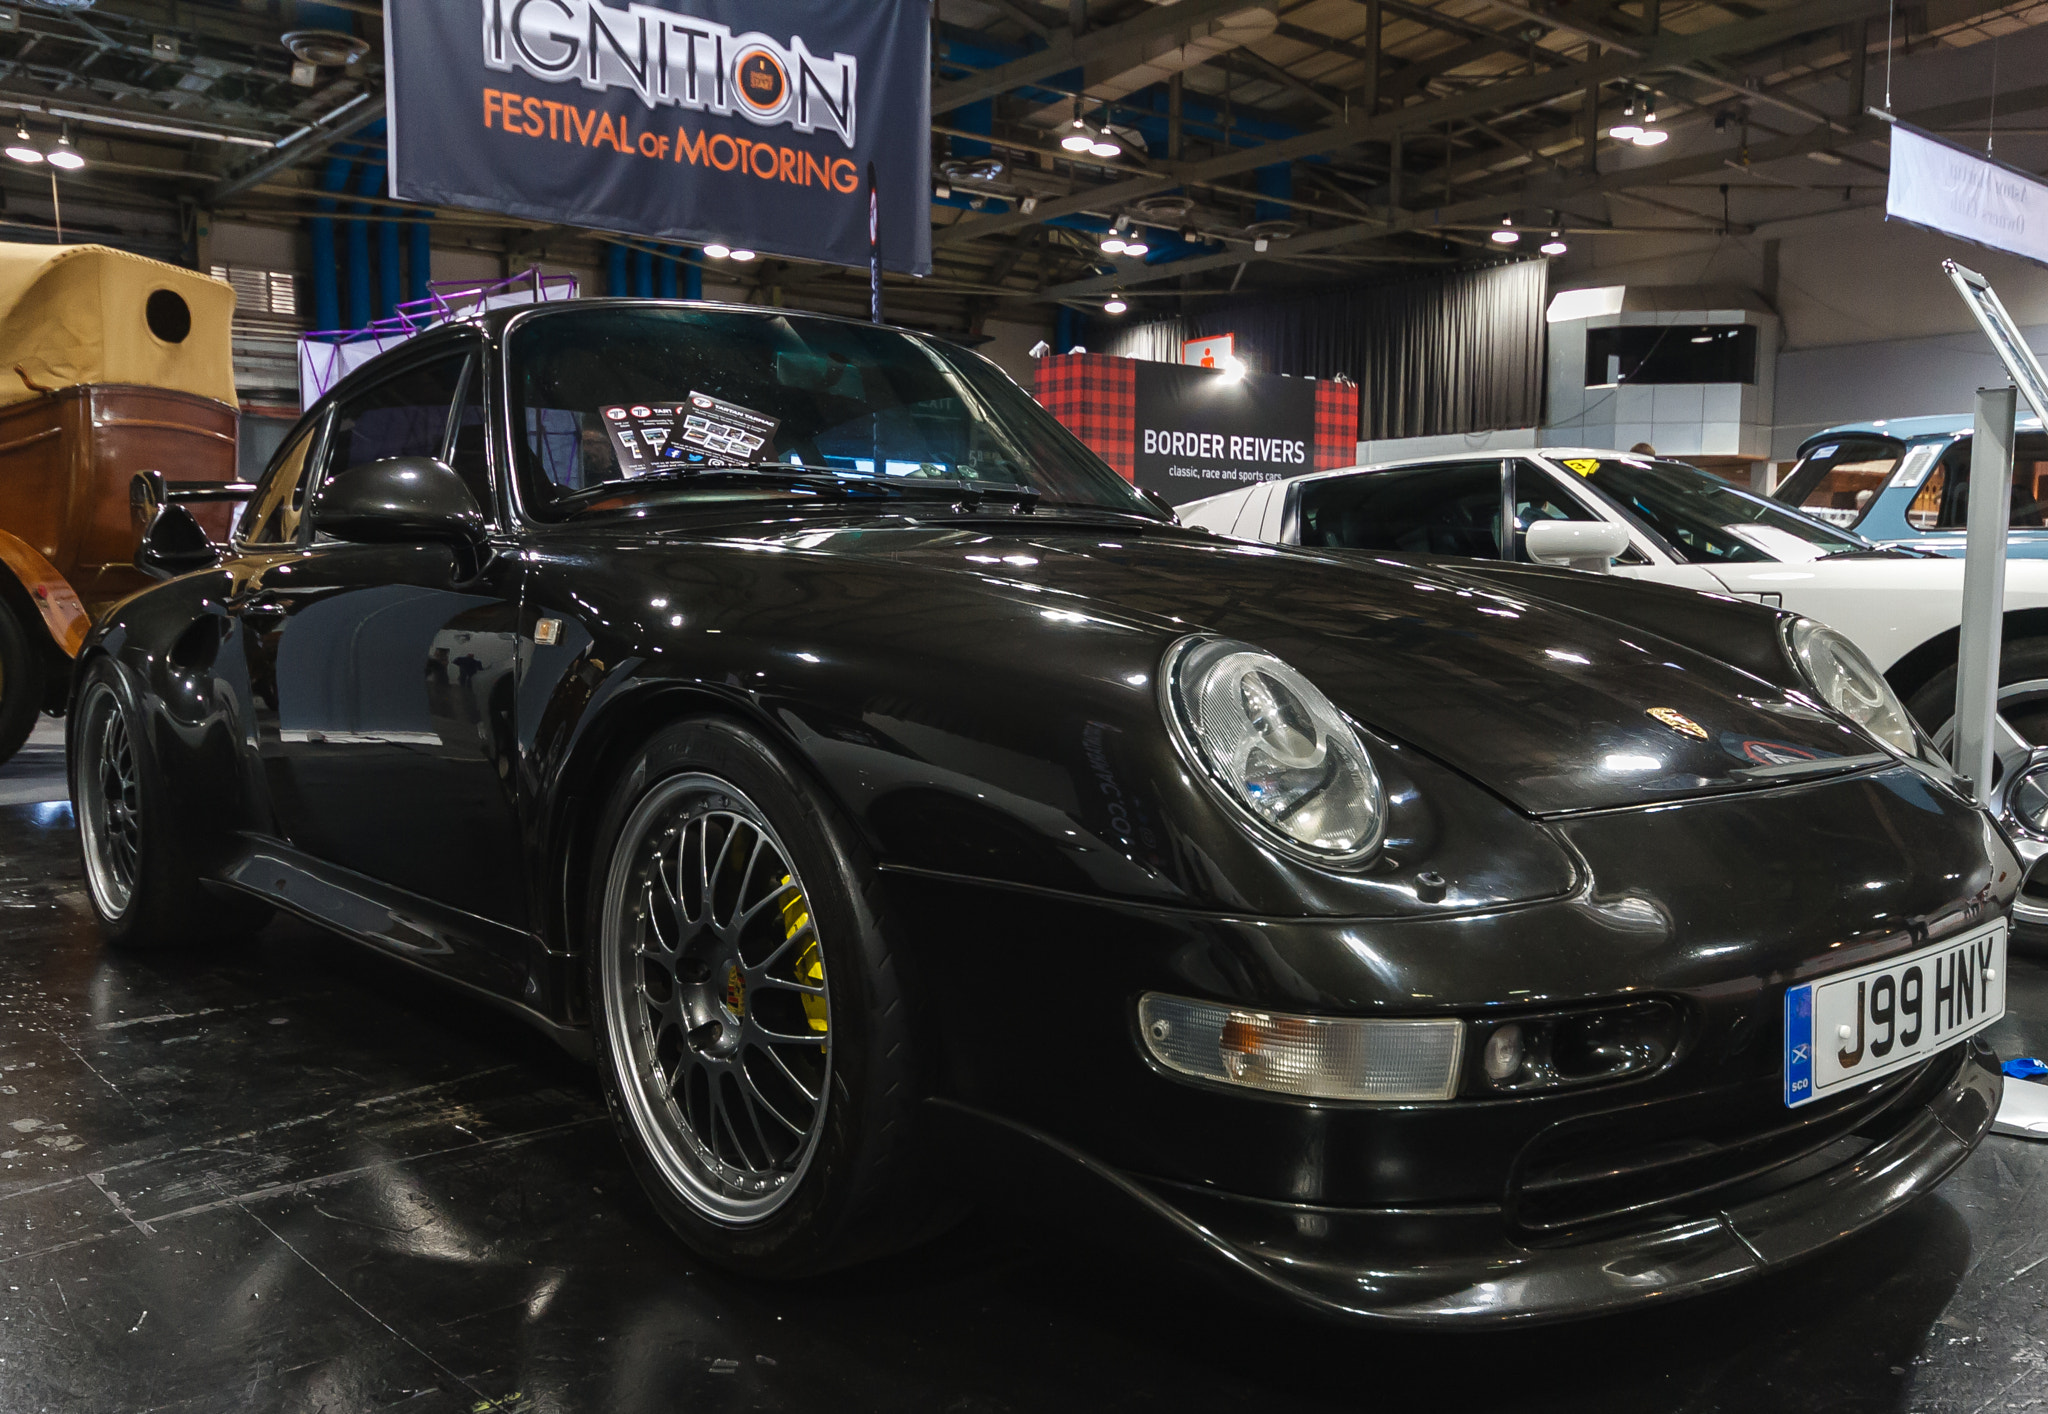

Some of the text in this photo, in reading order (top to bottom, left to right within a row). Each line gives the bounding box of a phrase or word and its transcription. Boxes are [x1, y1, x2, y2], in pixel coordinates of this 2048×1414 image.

[485, 0, 856, 145] IGNITION
[483, 87, 859, 194] FESTIVAL OF MOTORING
[714, 404, 744, 417] TARTAN
[744, 413, 775, 427] TARMAC
[1144, 429, 1305, 464] BORDER REIVERS
[1168, 464, 1283, 483] classic, race and sports cars
[1837, 936, 1994, 1069] J99 HNY
[1791, 1077, 1809, 1093] SCO
